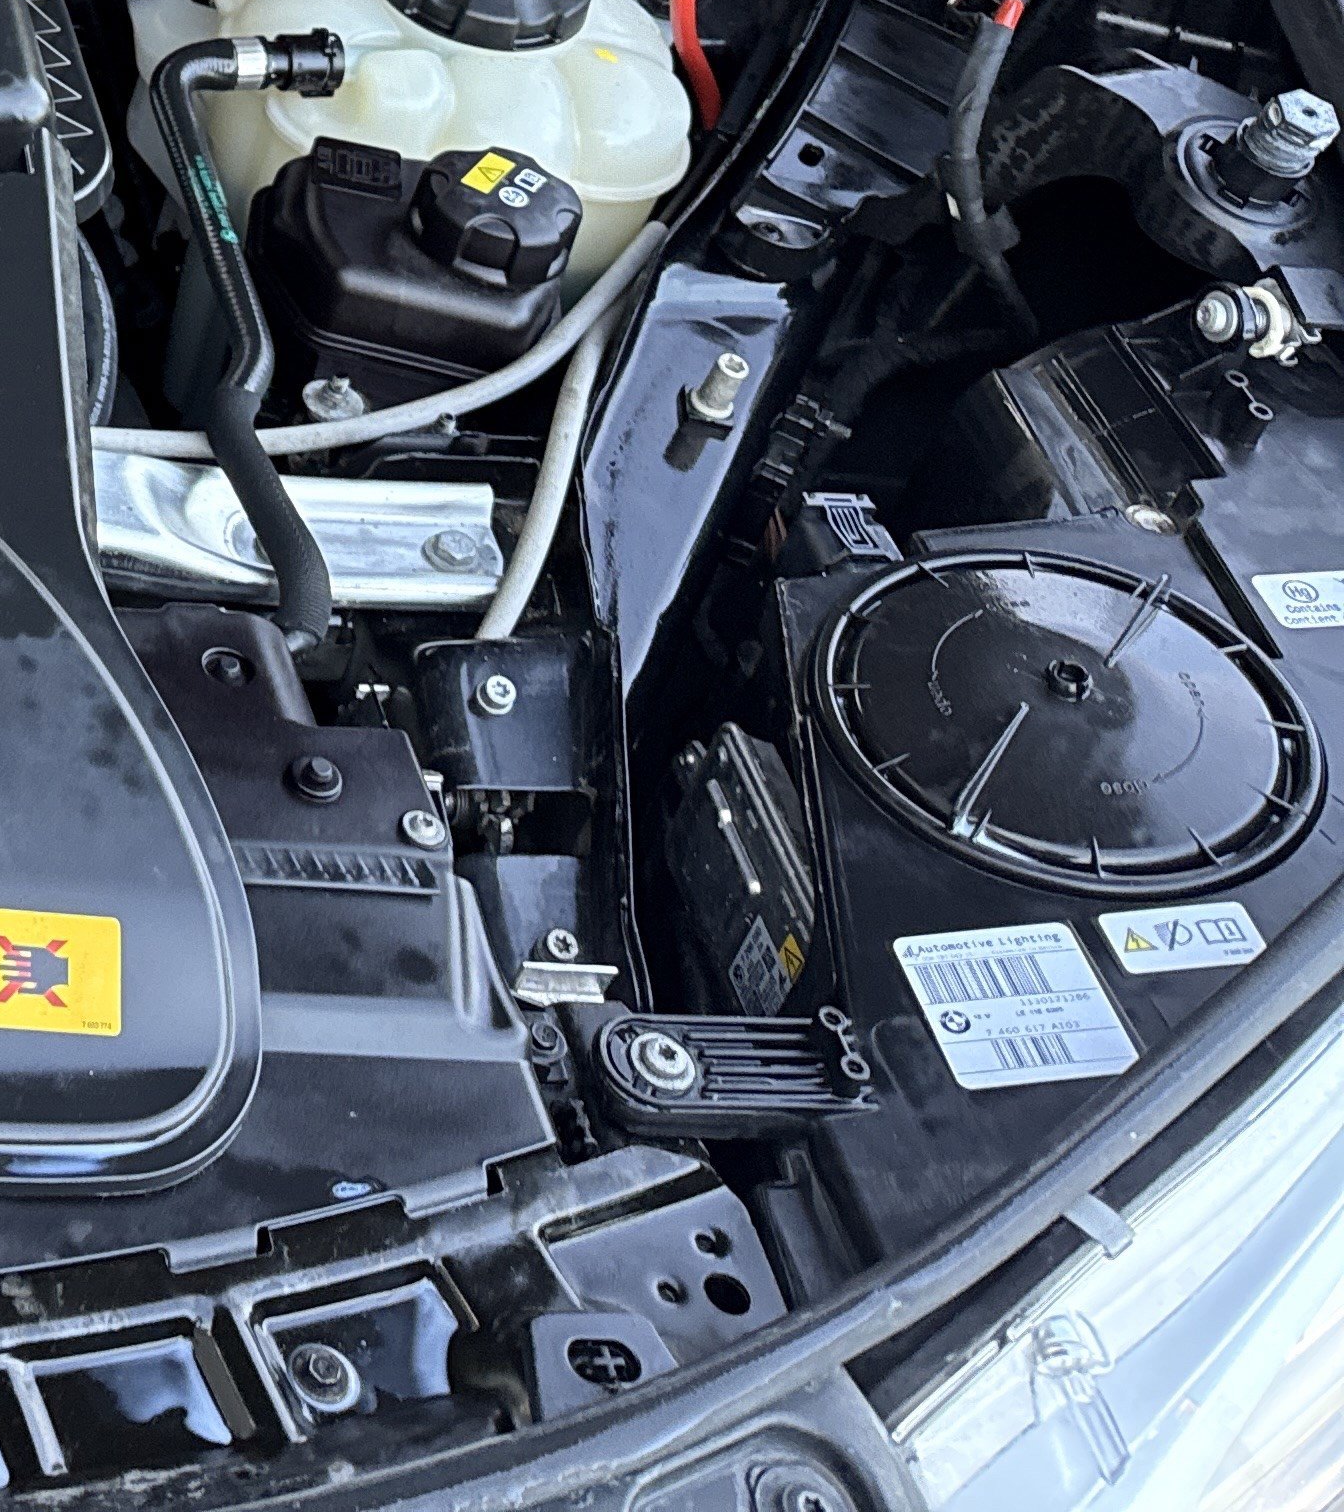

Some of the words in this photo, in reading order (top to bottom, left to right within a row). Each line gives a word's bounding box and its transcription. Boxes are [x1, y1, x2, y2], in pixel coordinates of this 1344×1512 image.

[1286, 585, 1313, 601] Hg
[1285, 603, 1341, 614] Contains
[1283, 614, 1339, 625] Contient
[917, 938, 994, 954] Automotive
[997, 932, 1062, 947] Lighting
